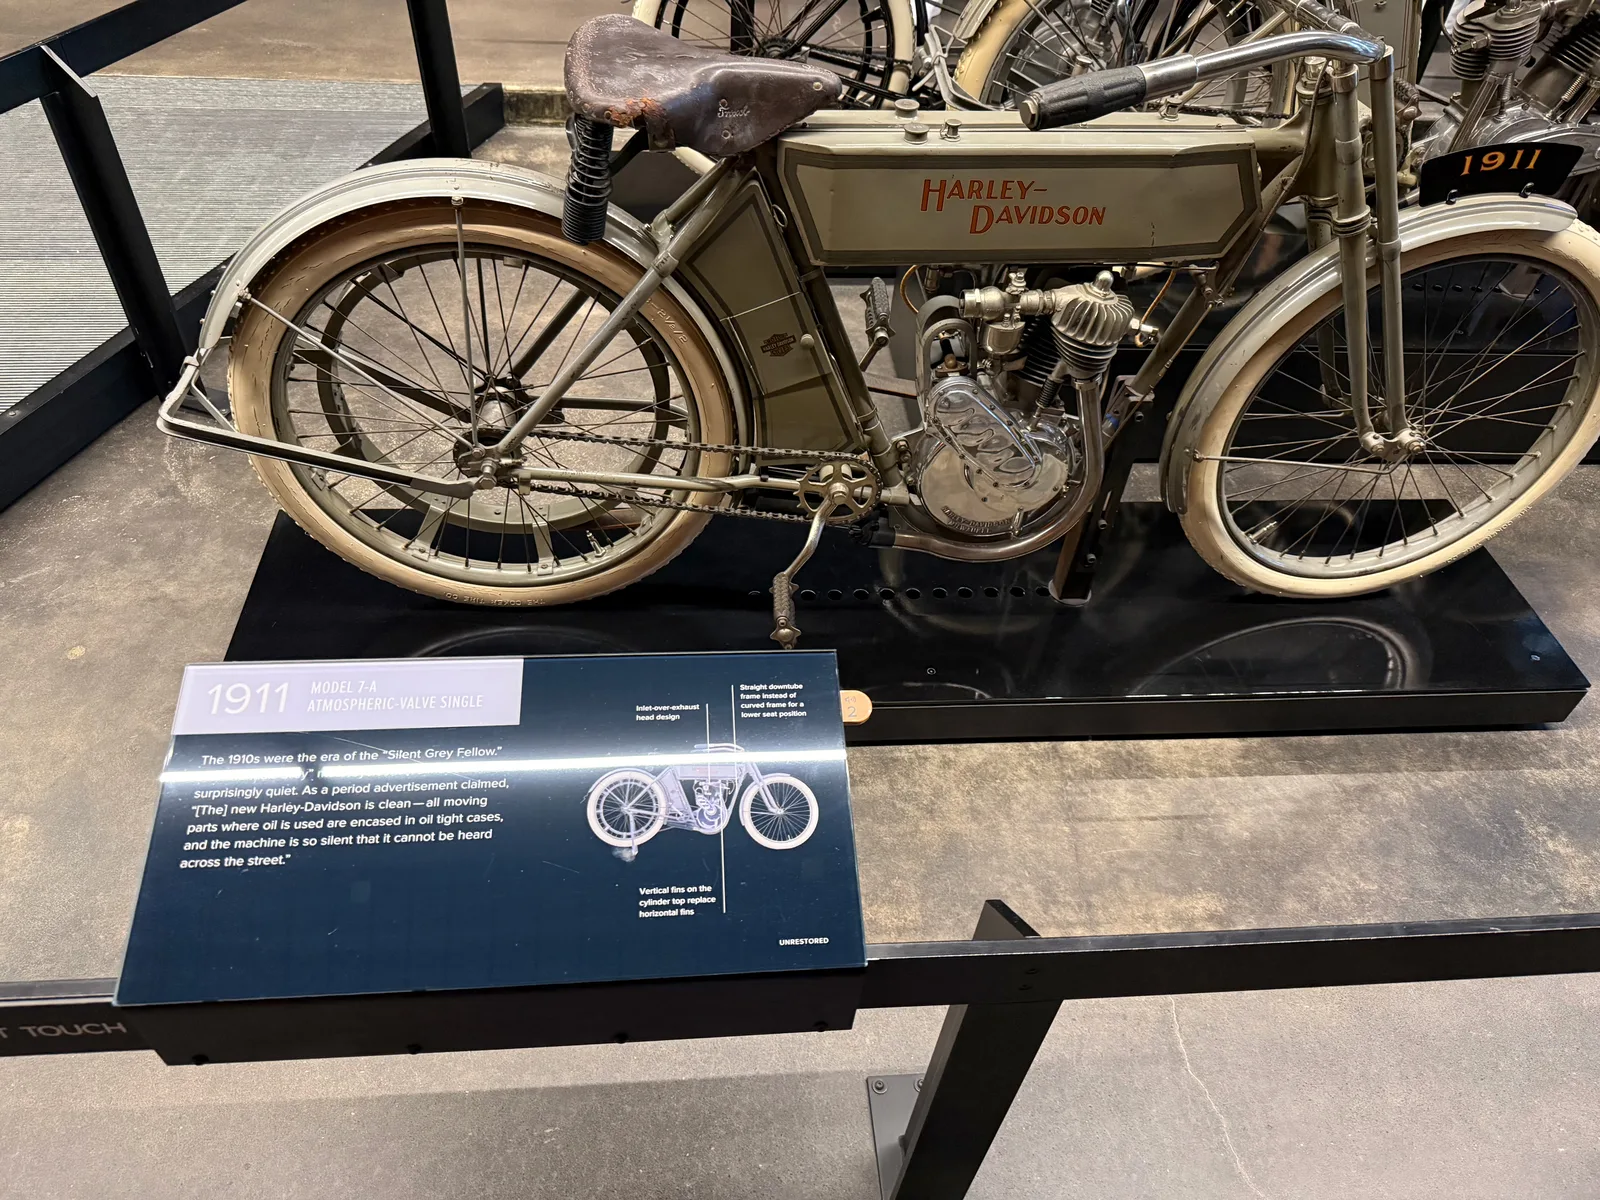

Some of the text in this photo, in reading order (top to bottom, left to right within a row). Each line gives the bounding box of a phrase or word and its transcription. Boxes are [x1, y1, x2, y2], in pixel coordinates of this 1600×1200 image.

[1460, 149, 1542, 177] 1911
[920, 178, 1048, 212] HARLEY-
[969, 204, 1106, 235] DAVIDSON
[311, 680, 377, 694] MODEL 7-A
[740, 683, 768, 692] Straight
[207, 682, 289, 715] 1911
[307, 695, 484, 712] ATMOSPHERIC-VALVE SINGLE
[636, 703, 700, 712] Inlet-over-exhaust
[779, 710, 807, 718] position
[847, 705, 858, 718] 2
[656, 713, 680, 721] design
[202, 746, 503, 765] The 1910s were the era of the “Silent Grey Fellow.”
[194, 778, 509, 800] surprisingly quiet. As a period advertisement claimed,
[192, 804, 228, 817] “[The]
[231, 806, 257, 814] new
[260, 801, 361, 815] Harley-Davidson
[364, 800, 375, 810] is
[443, 796, 488, 807] moving
[186, 813, 504, 835] parts where oil is used are encased in oil tight cases,
[183, 828, 493, 850] and the machine is so silent that it cannot be heard
[179, 854, 291, 869] across the street.”
[639, 886, 670, 895] Vertical
[671, 886, 686, 894] fins
[639, 895, 717, 908] cylinder top replace
[639, 908, 695, 918] horizontal fins
[779, 937, 830, 946] UNRESTORED
[19, 1022, 127, 1037] TOUCH
